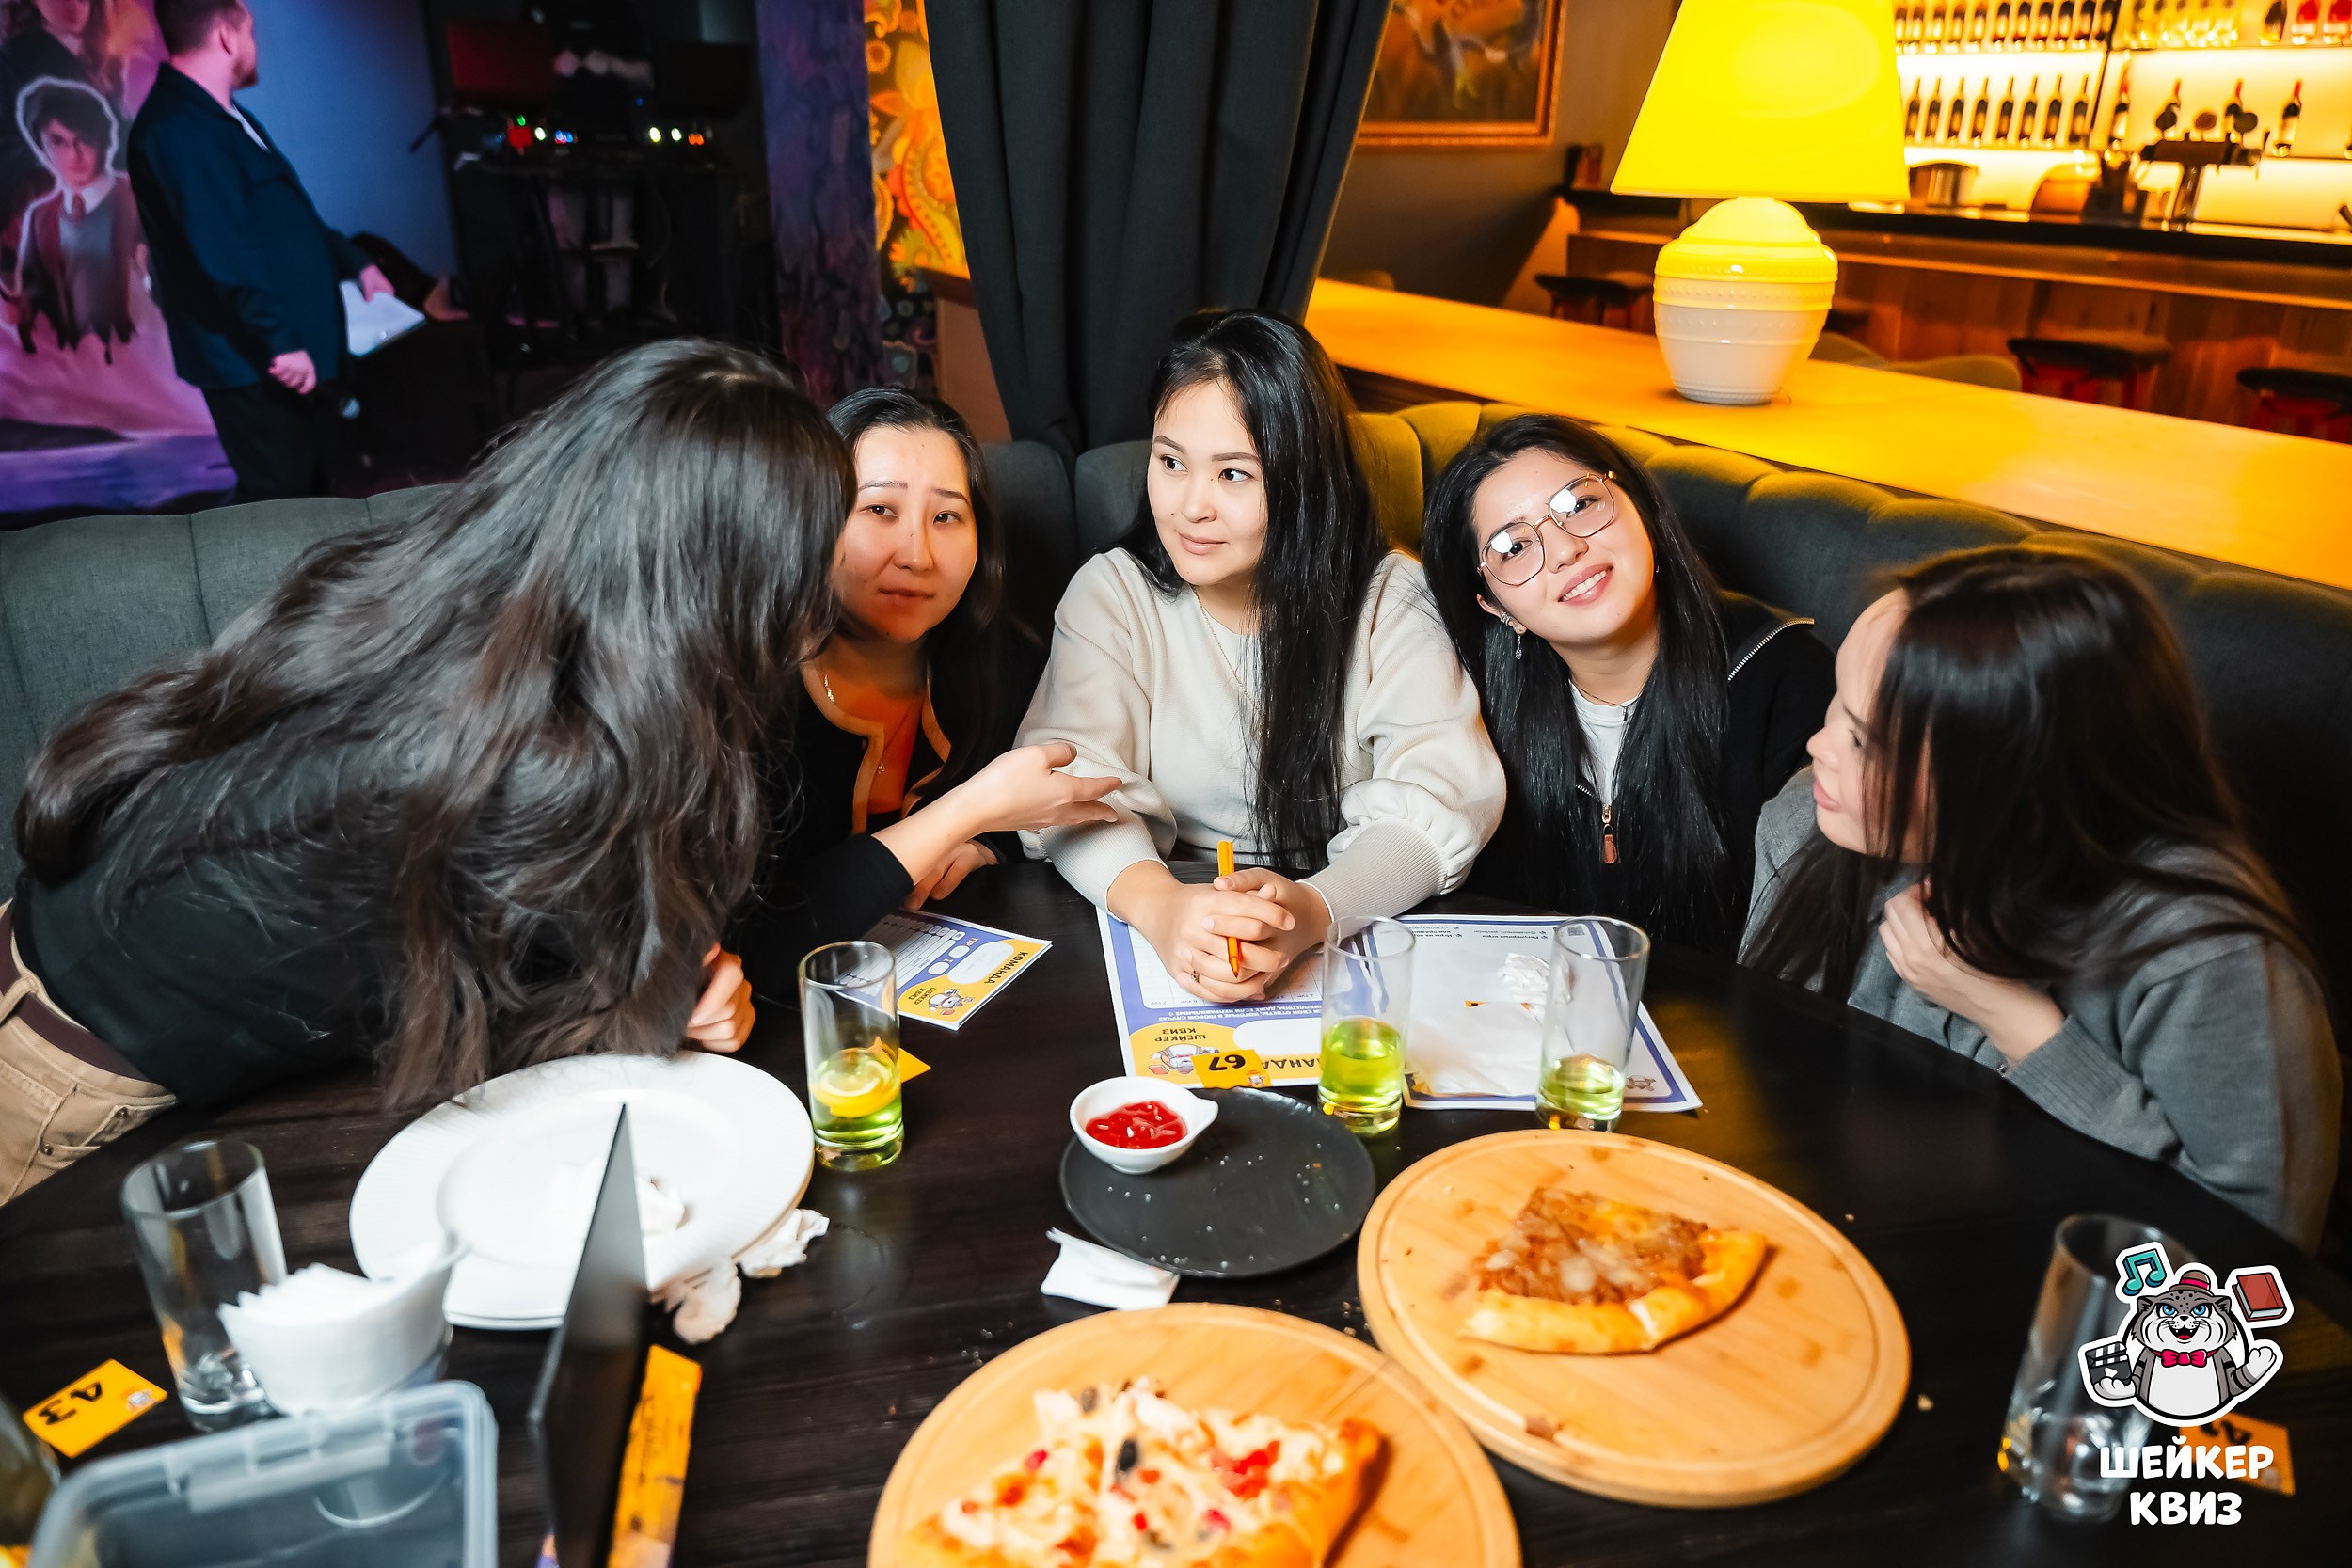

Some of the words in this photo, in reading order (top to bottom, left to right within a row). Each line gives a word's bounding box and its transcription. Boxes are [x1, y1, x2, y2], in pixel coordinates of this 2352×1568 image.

[984, 951, 1028, 984] КОМАНДА
[1154, 1034, 1206, 1042] ШЕЙКЕР
[1208, 1054, 1247, 1071] 67
